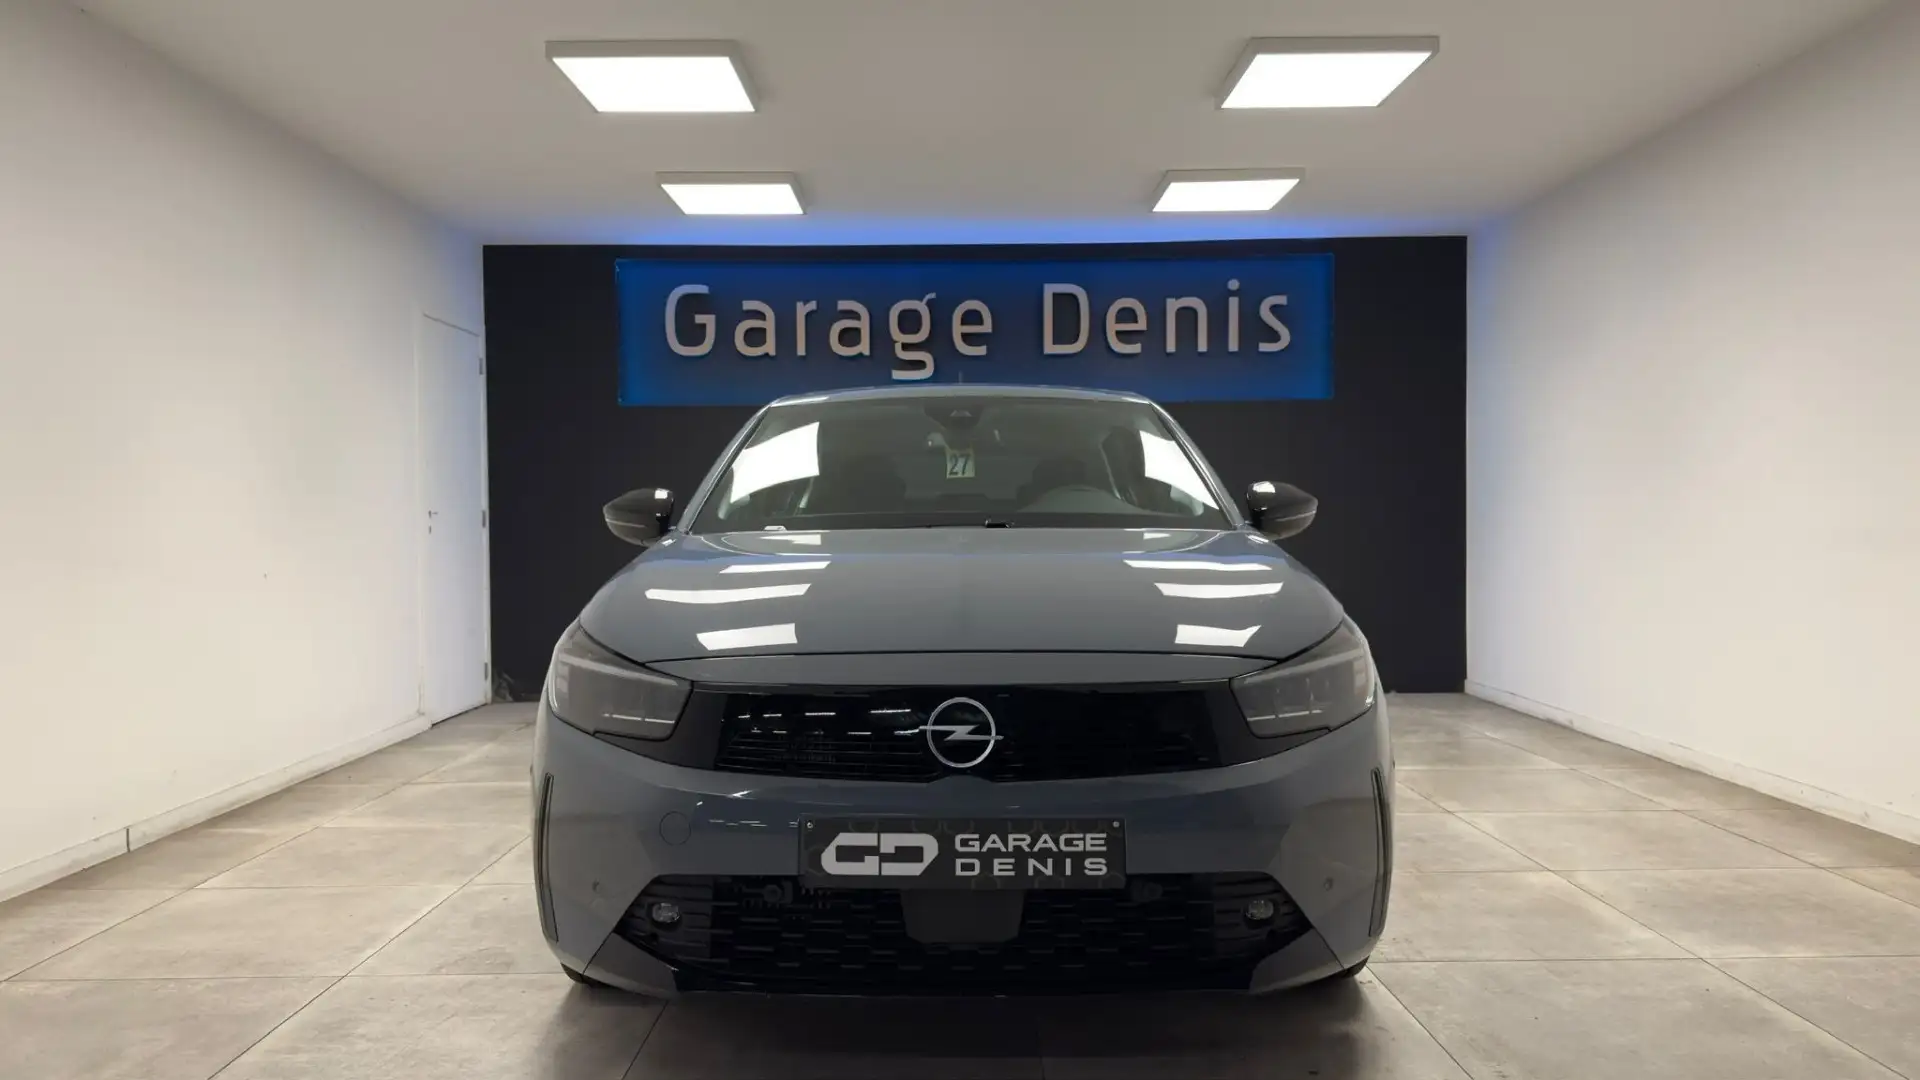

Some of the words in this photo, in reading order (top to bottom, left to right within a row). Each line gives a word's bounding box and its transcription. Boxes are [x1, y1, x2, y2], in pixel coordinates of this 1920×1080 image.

[664, 283, 993, 380] Garage
[1042, 279, 1292, 356] Denis
[949, 453, 970, 476] 27
[954, 833, 1107, 852] GARAGE
[955, 858, 1108, 876] DENIS
